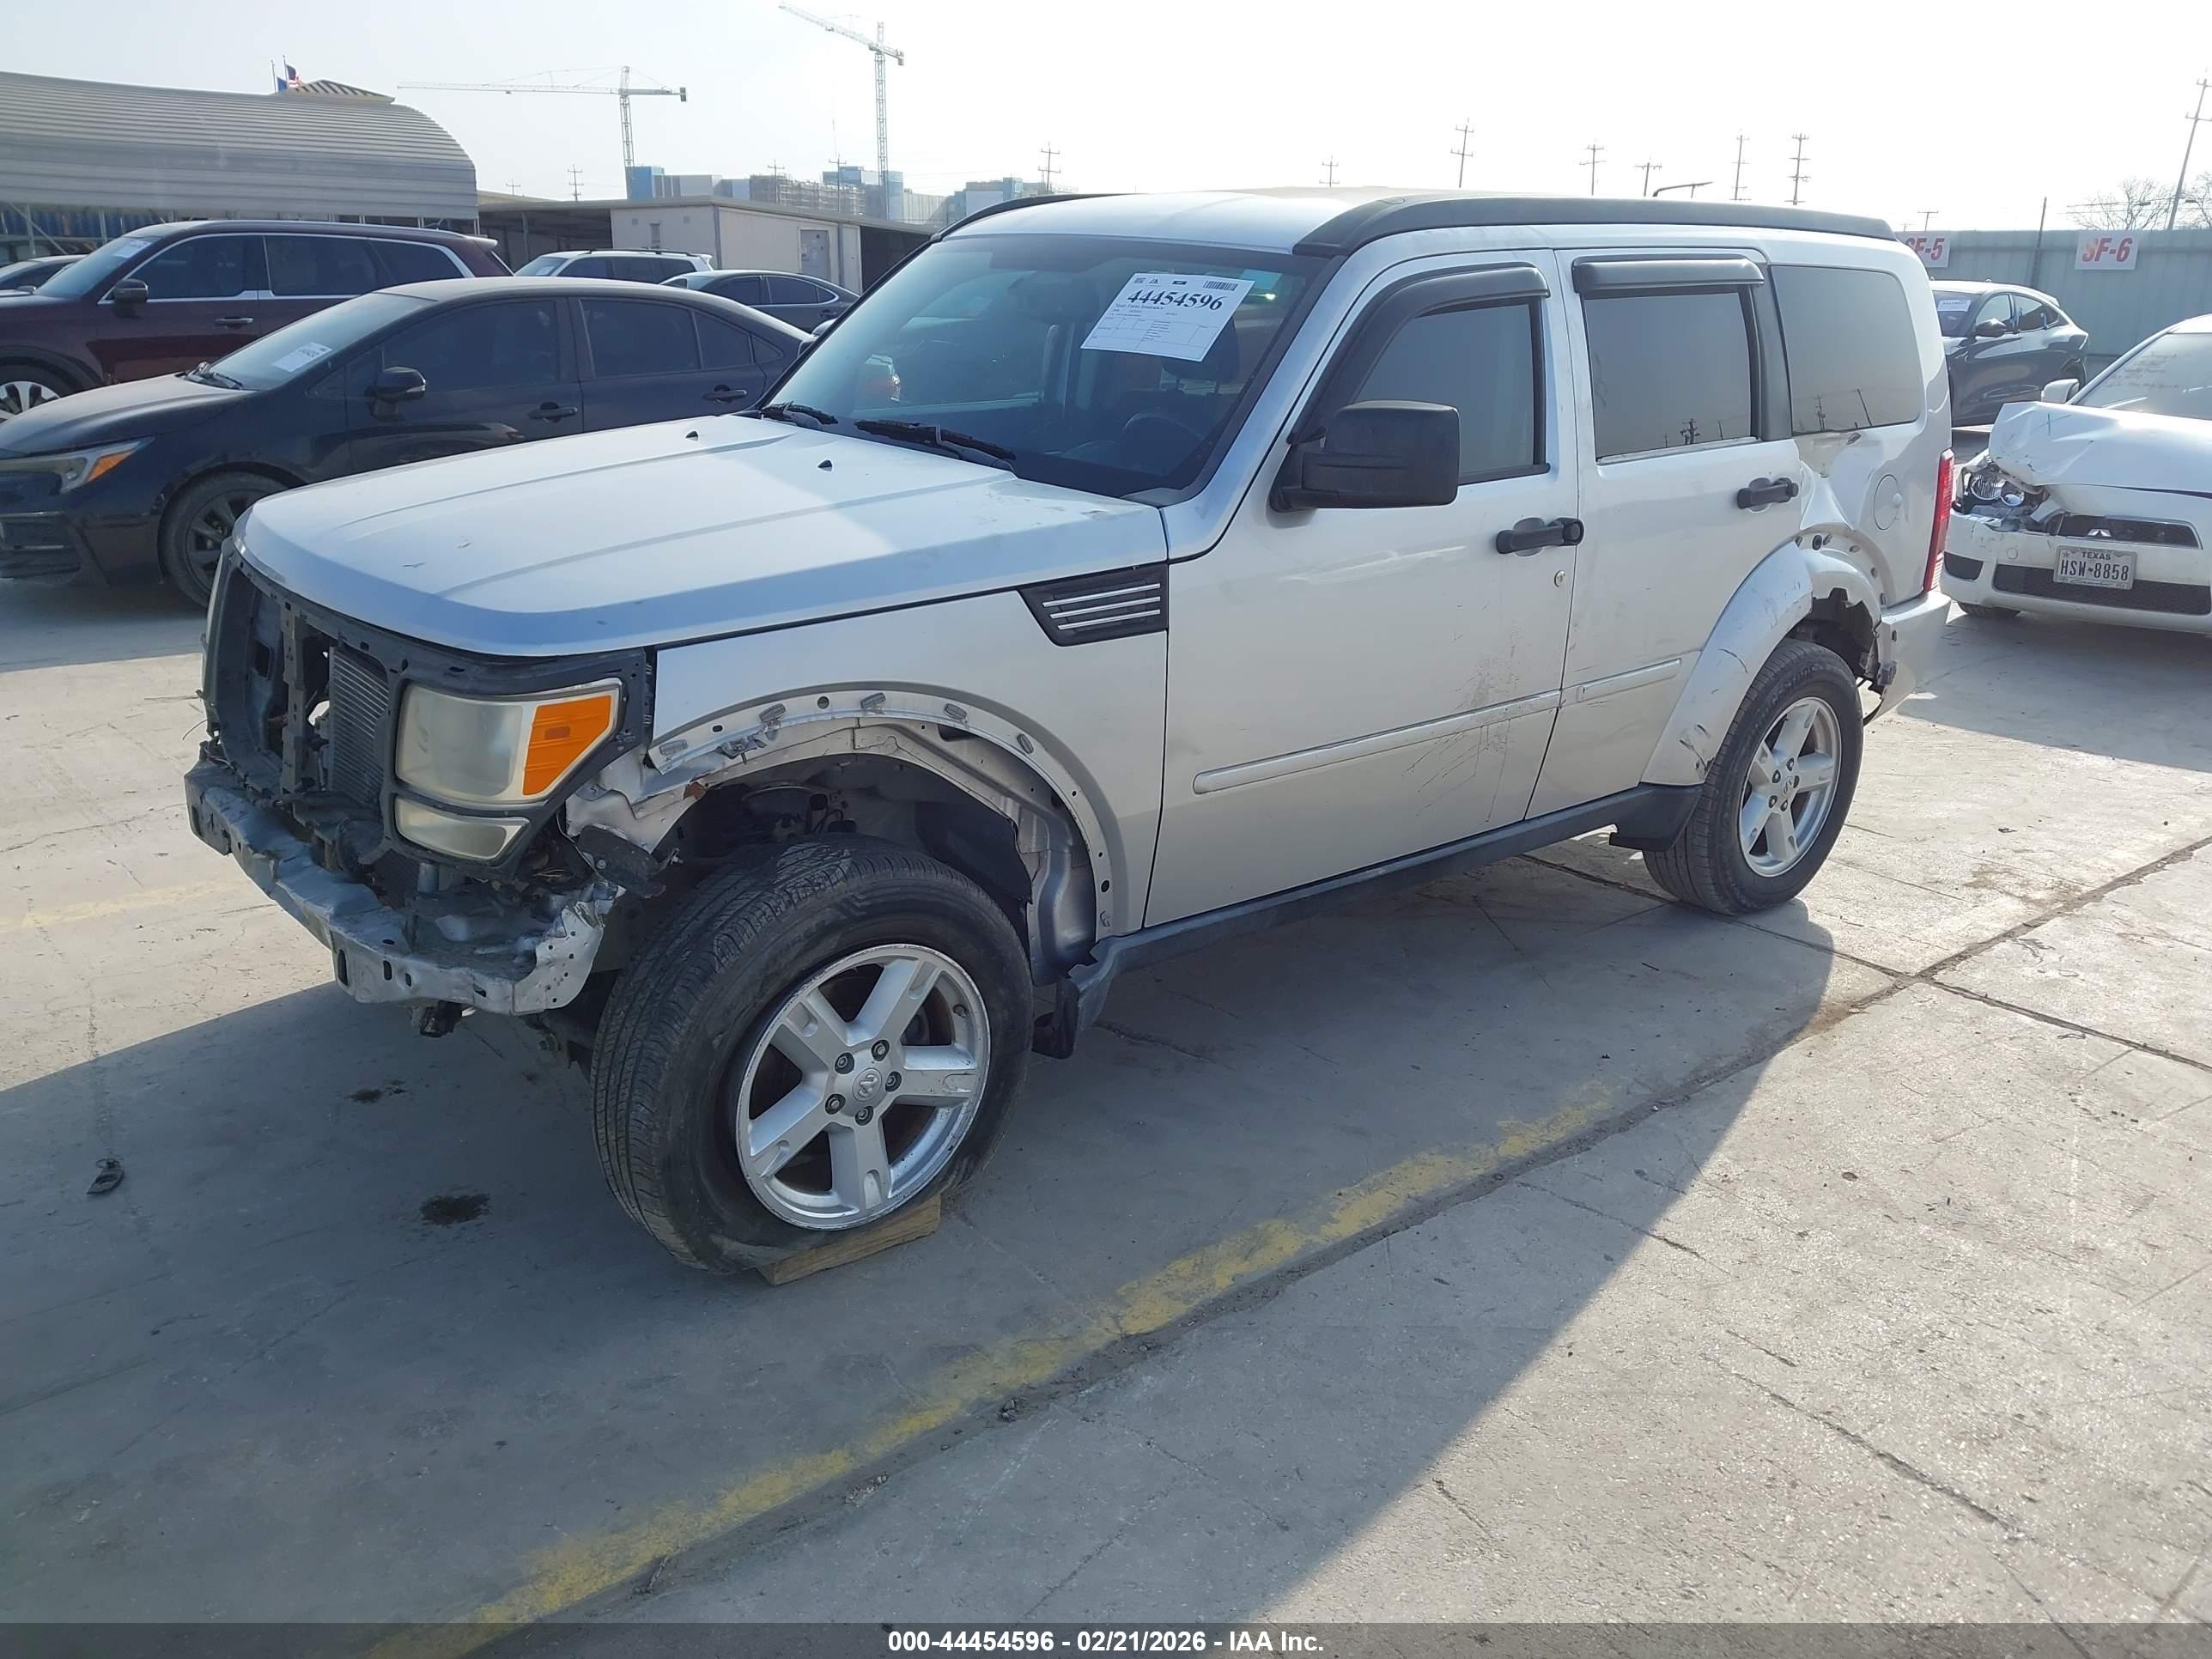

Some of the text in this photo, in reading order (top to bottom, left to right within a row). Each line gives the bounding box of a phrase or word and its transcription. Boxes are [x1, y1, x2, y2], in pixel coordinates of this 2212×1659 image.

[2081, 237, 2132, 262] SF-6
[1127, 289, 1229, 311] 44454596
[2081, 551, 2112, 561] TEXAS
